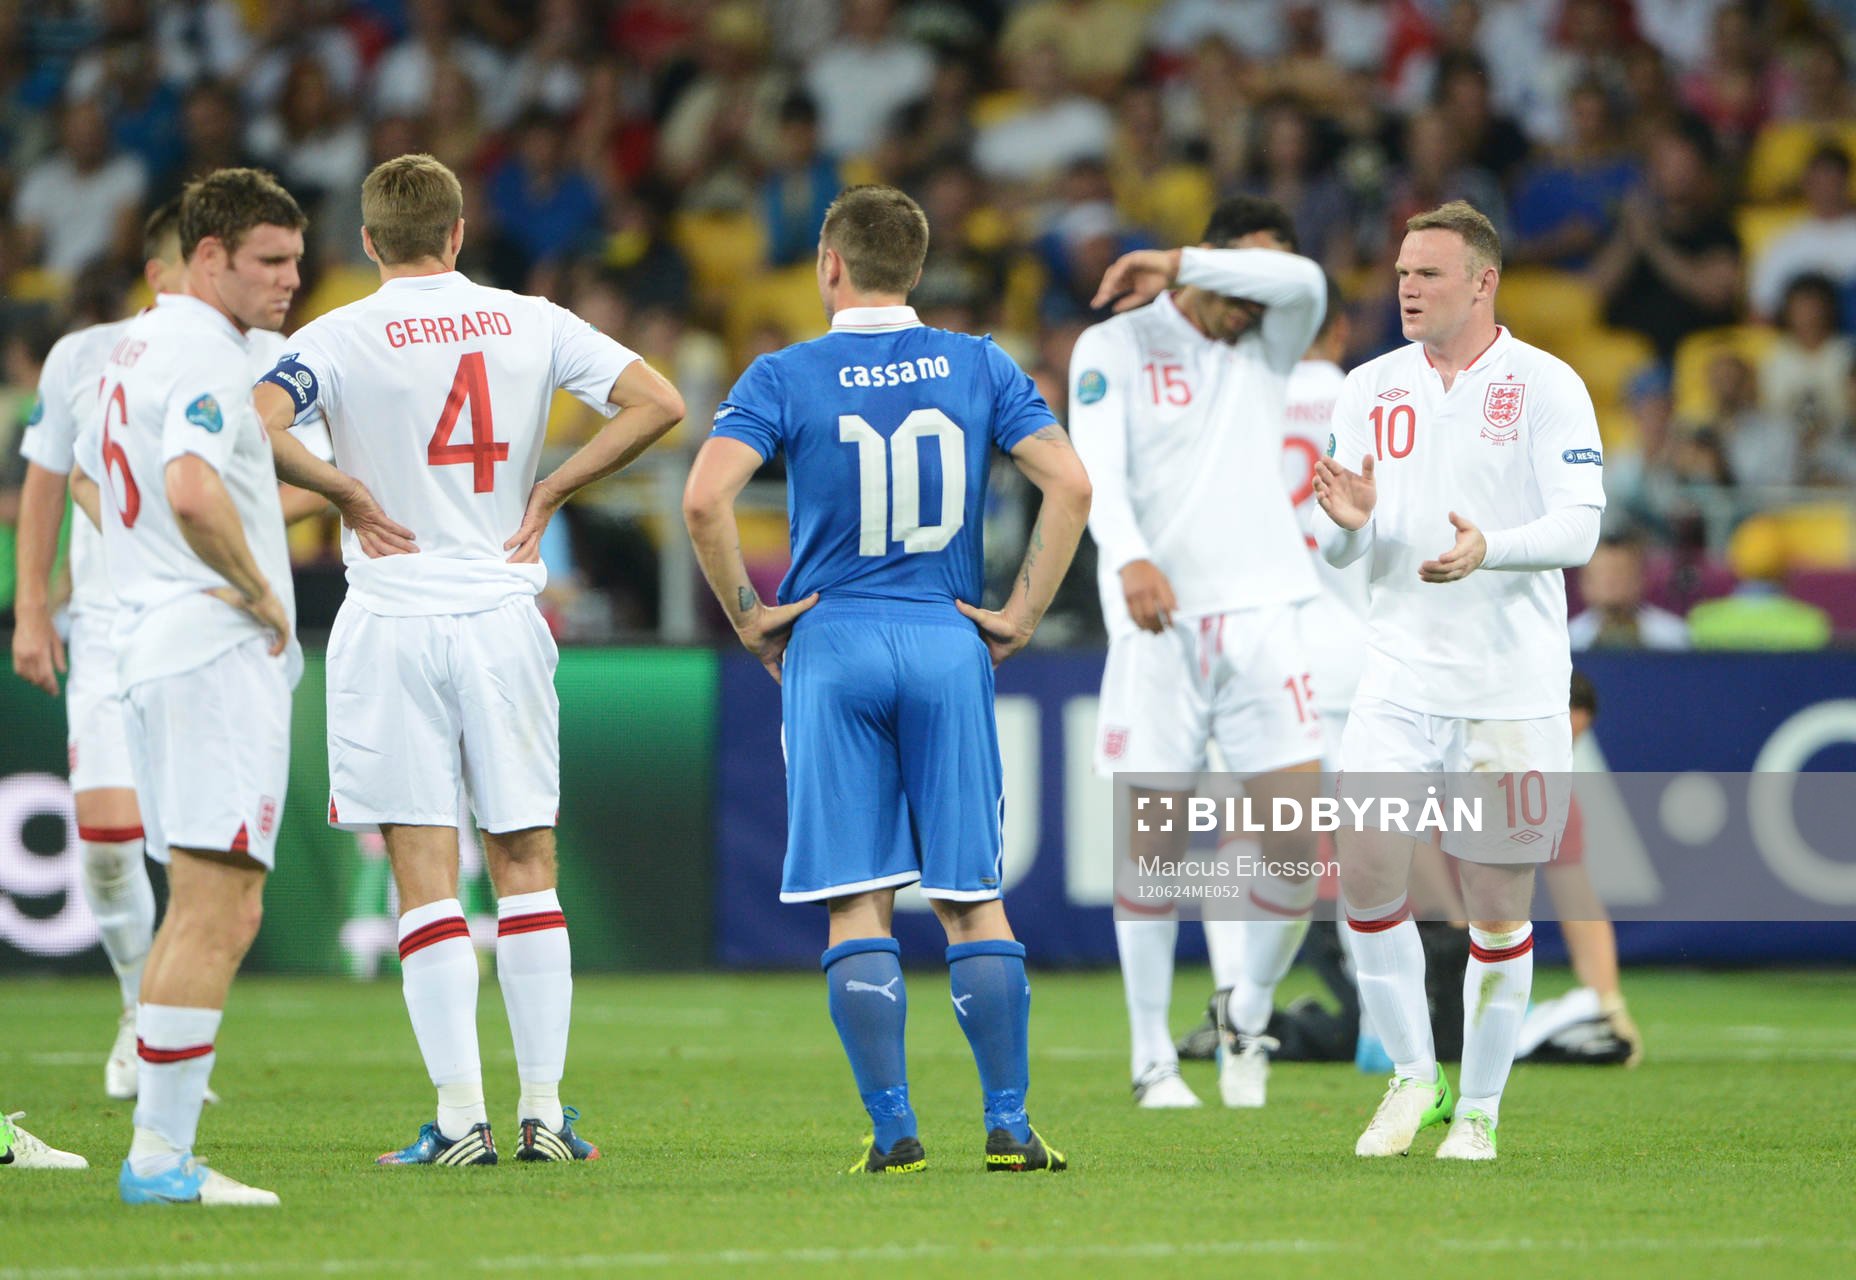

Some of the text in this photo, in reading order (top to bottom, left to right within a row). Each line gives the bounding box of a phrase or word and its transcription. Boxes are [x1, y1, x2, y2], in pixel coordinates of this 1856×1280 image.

[385, 311, 512, 348] GERRARD
[1143, 363, 1192, 407] 15
[428, 351, 509, 493] 4
[1369, 404, 1416, 461] 10
[98, 376, 141, 529] 6
[838, 408, 967, 556] 10
[1498, 769, 1547, 829] 10
[986, 1154, 1027, 1164] ADORA
